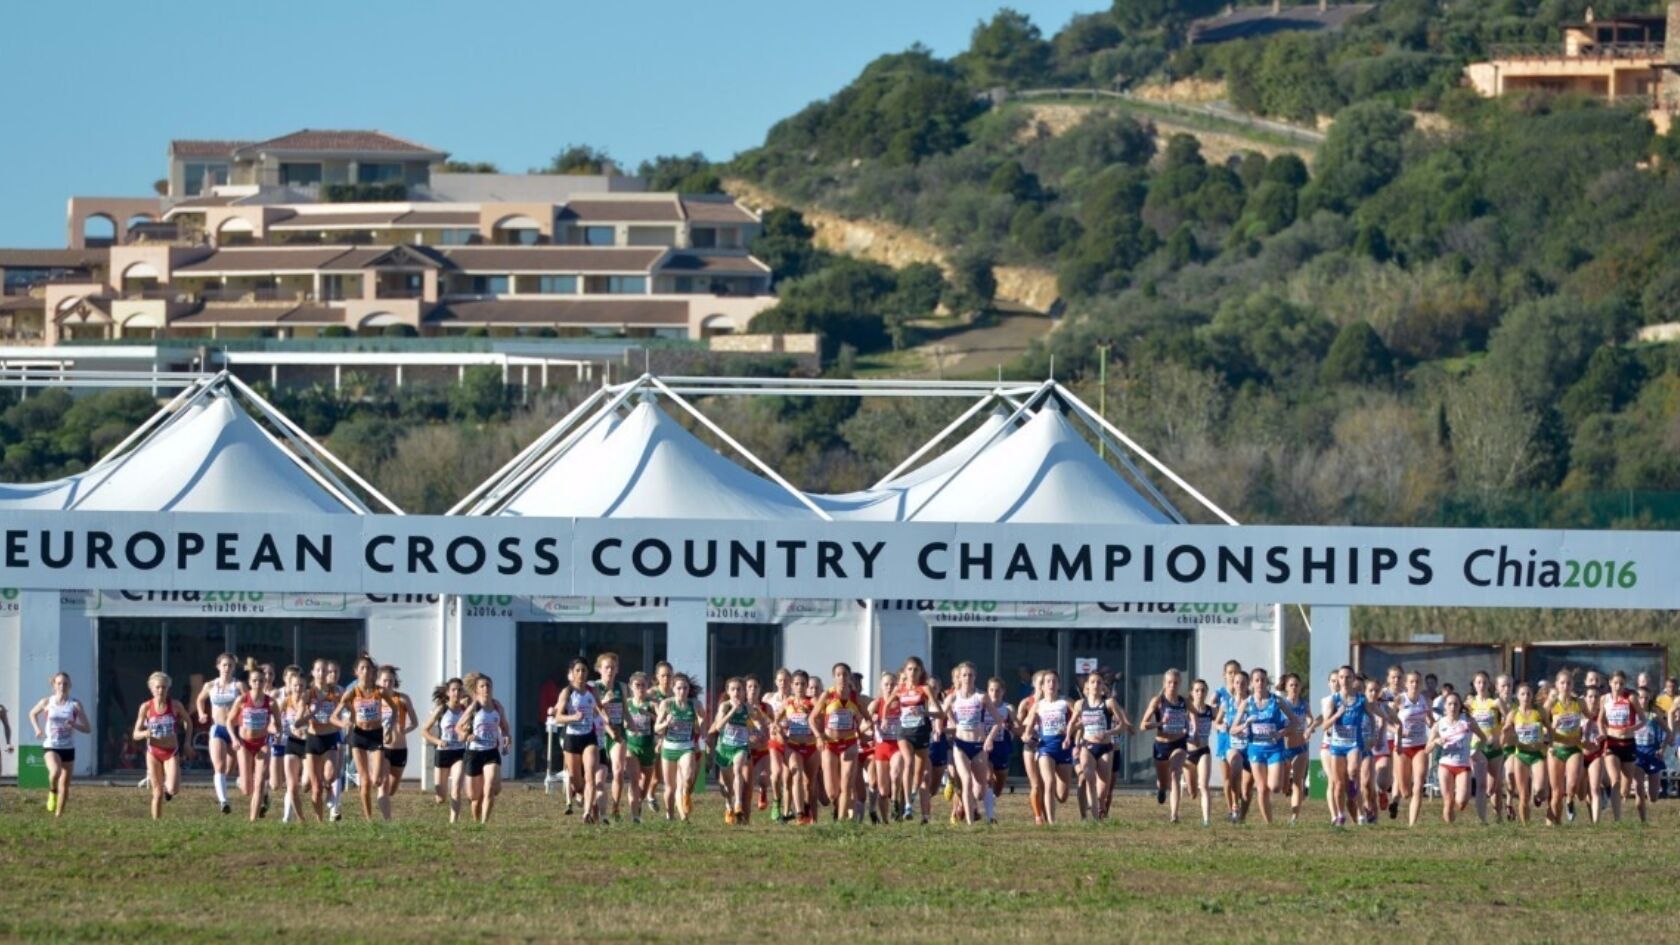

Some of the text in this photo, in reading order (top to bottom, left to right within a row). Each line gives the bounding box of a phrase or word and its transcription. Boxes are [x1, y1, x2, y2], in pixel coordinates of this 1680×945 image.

[5, 530, 1637, 589] EUROPEAN CROSS COUNTRY CHAMPIONSHIPS Chia2016
[1177, 615, 1239, 625] chia2016.eu
